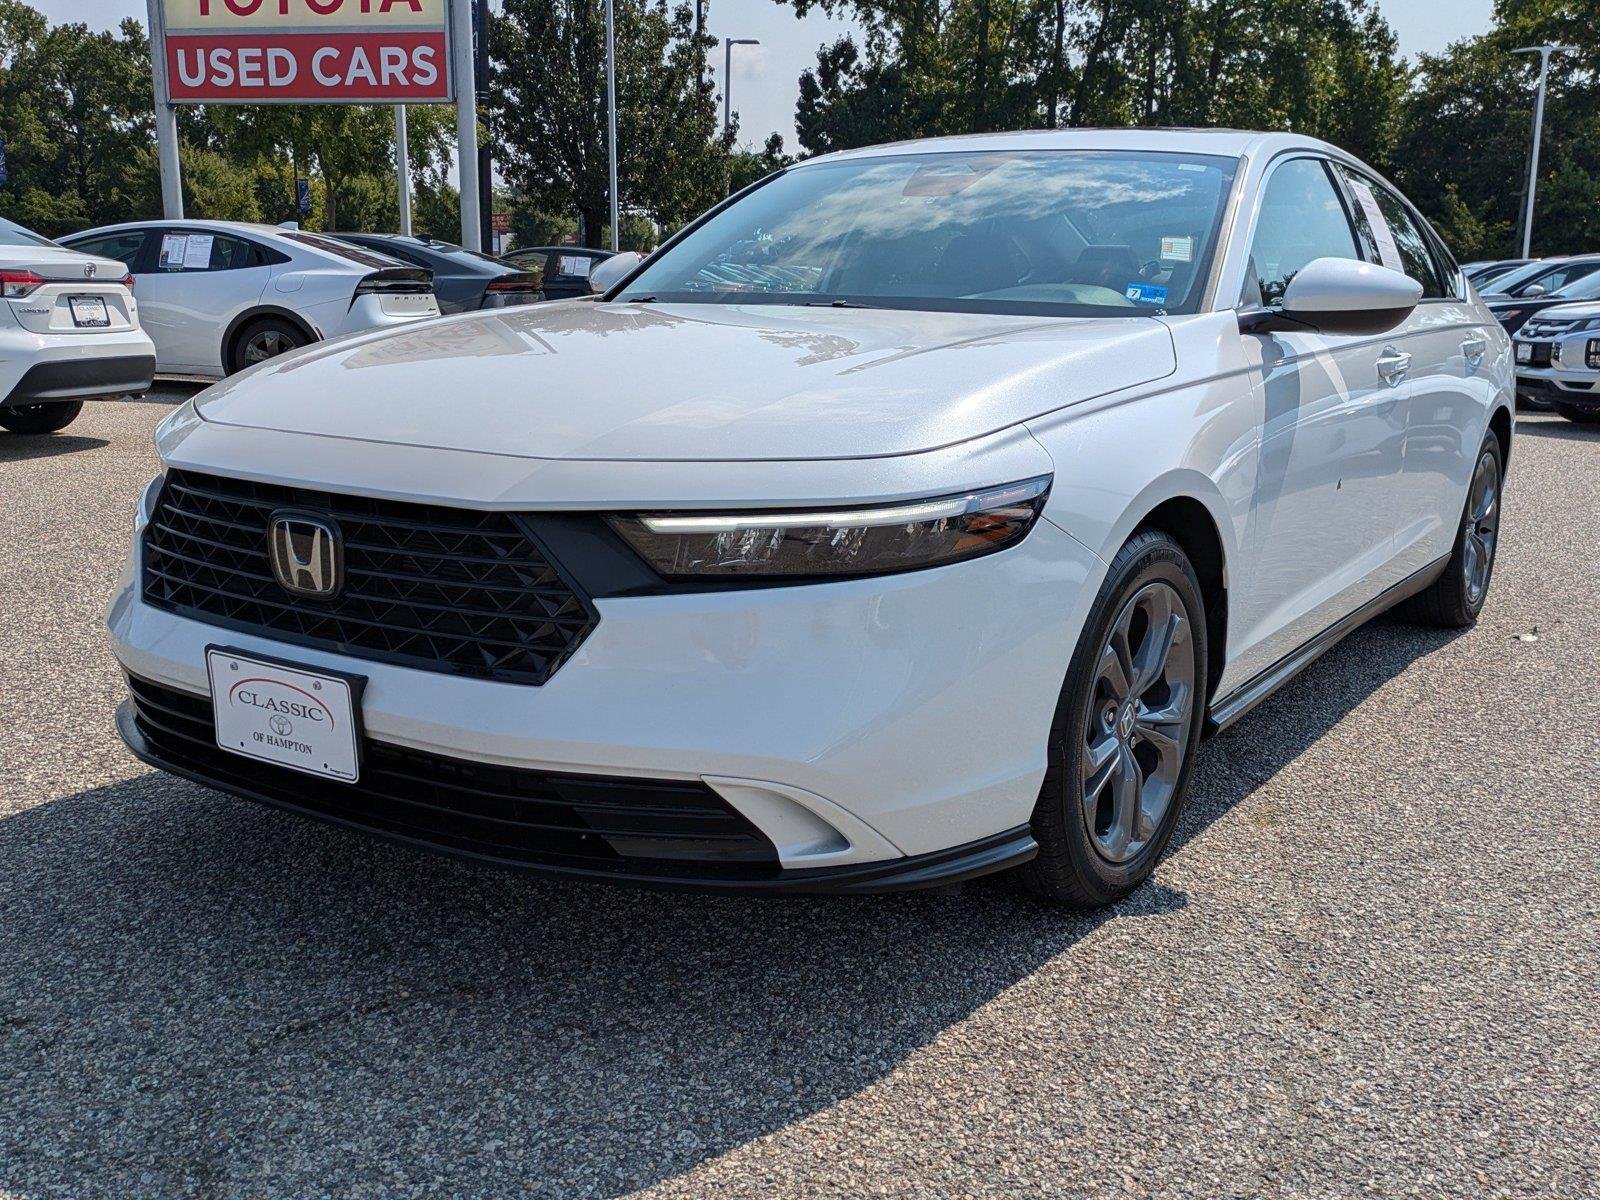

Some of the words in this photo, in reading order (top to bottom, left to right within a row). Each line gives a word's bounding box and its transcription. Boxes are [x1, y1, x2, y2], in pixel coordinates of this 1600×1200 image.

[177, 48, 298, 87] USED
[311, 45, 438, 87] CARS
[1131, 289, 1138, 297] 7
[238, 690, 324, 722] CLASSIC
[253, 731, 265, 743] OF
[267, 734, 313, 755] HAMPTON
